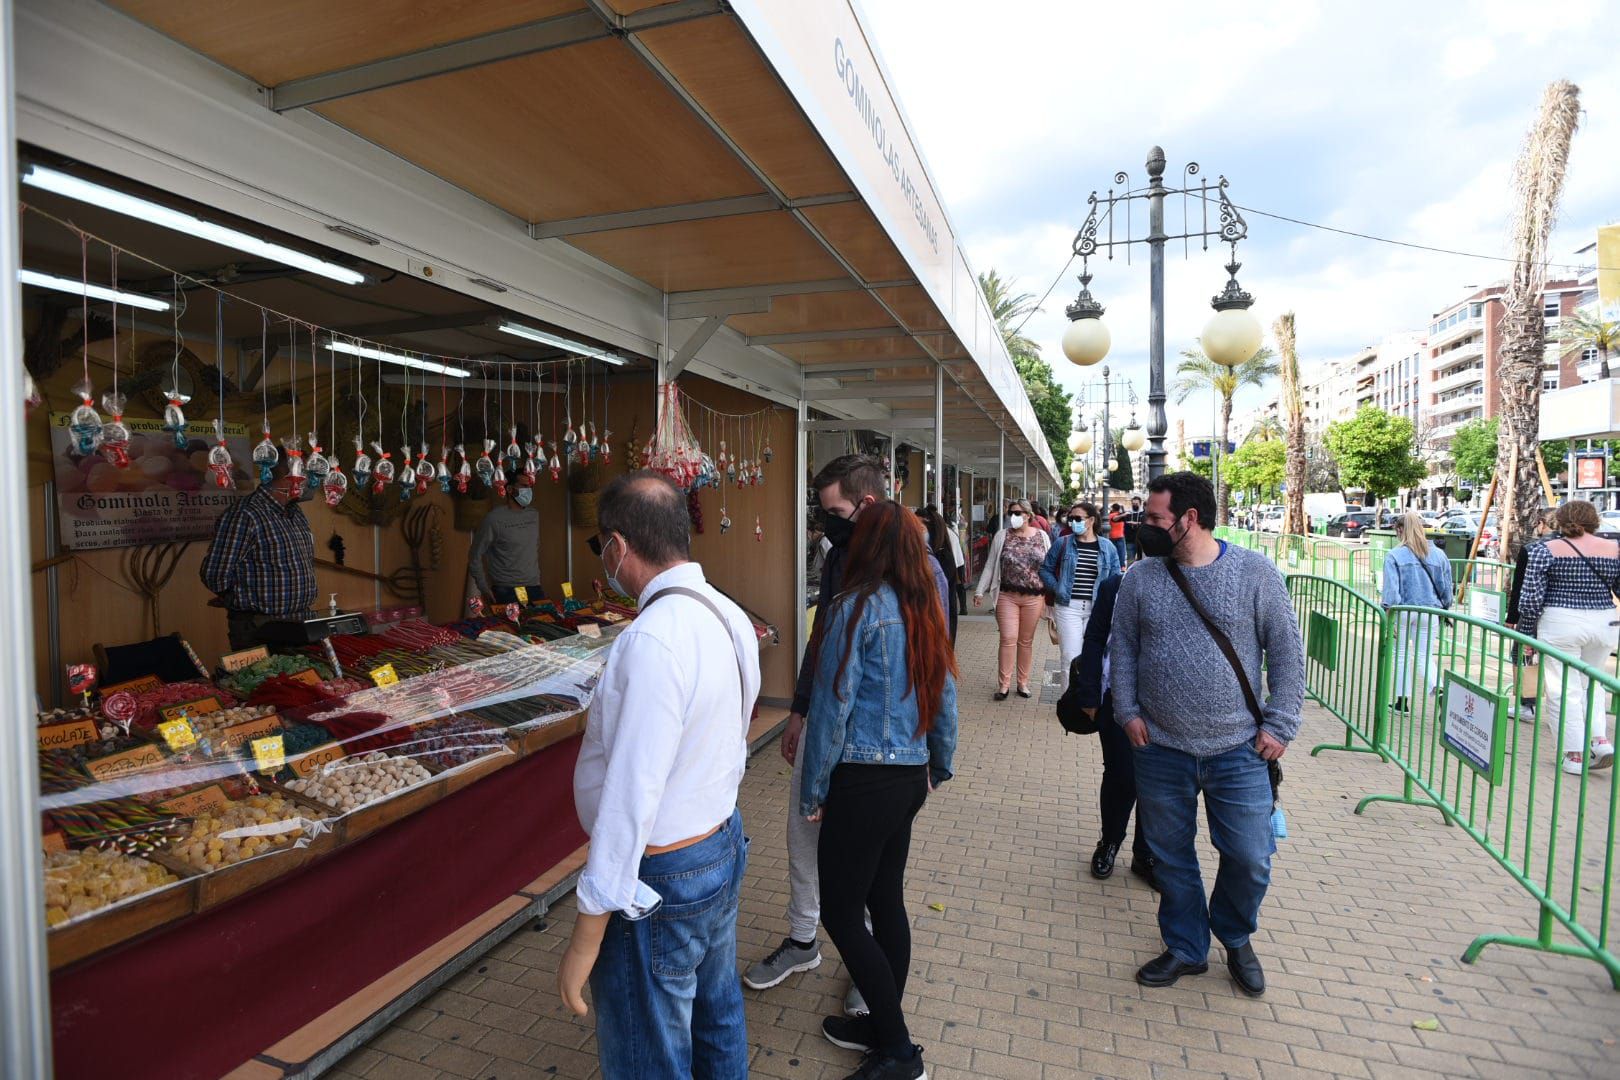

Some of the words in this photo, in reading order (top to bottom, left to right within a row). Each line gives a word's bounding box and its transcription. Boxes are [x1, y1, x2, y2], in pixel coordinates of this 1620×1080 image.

[834, 37, 900, 183] GOMINOLAS
[900, 170, 939, 255] ARTESANAS
[77, 493, 170, 510] Gominola
